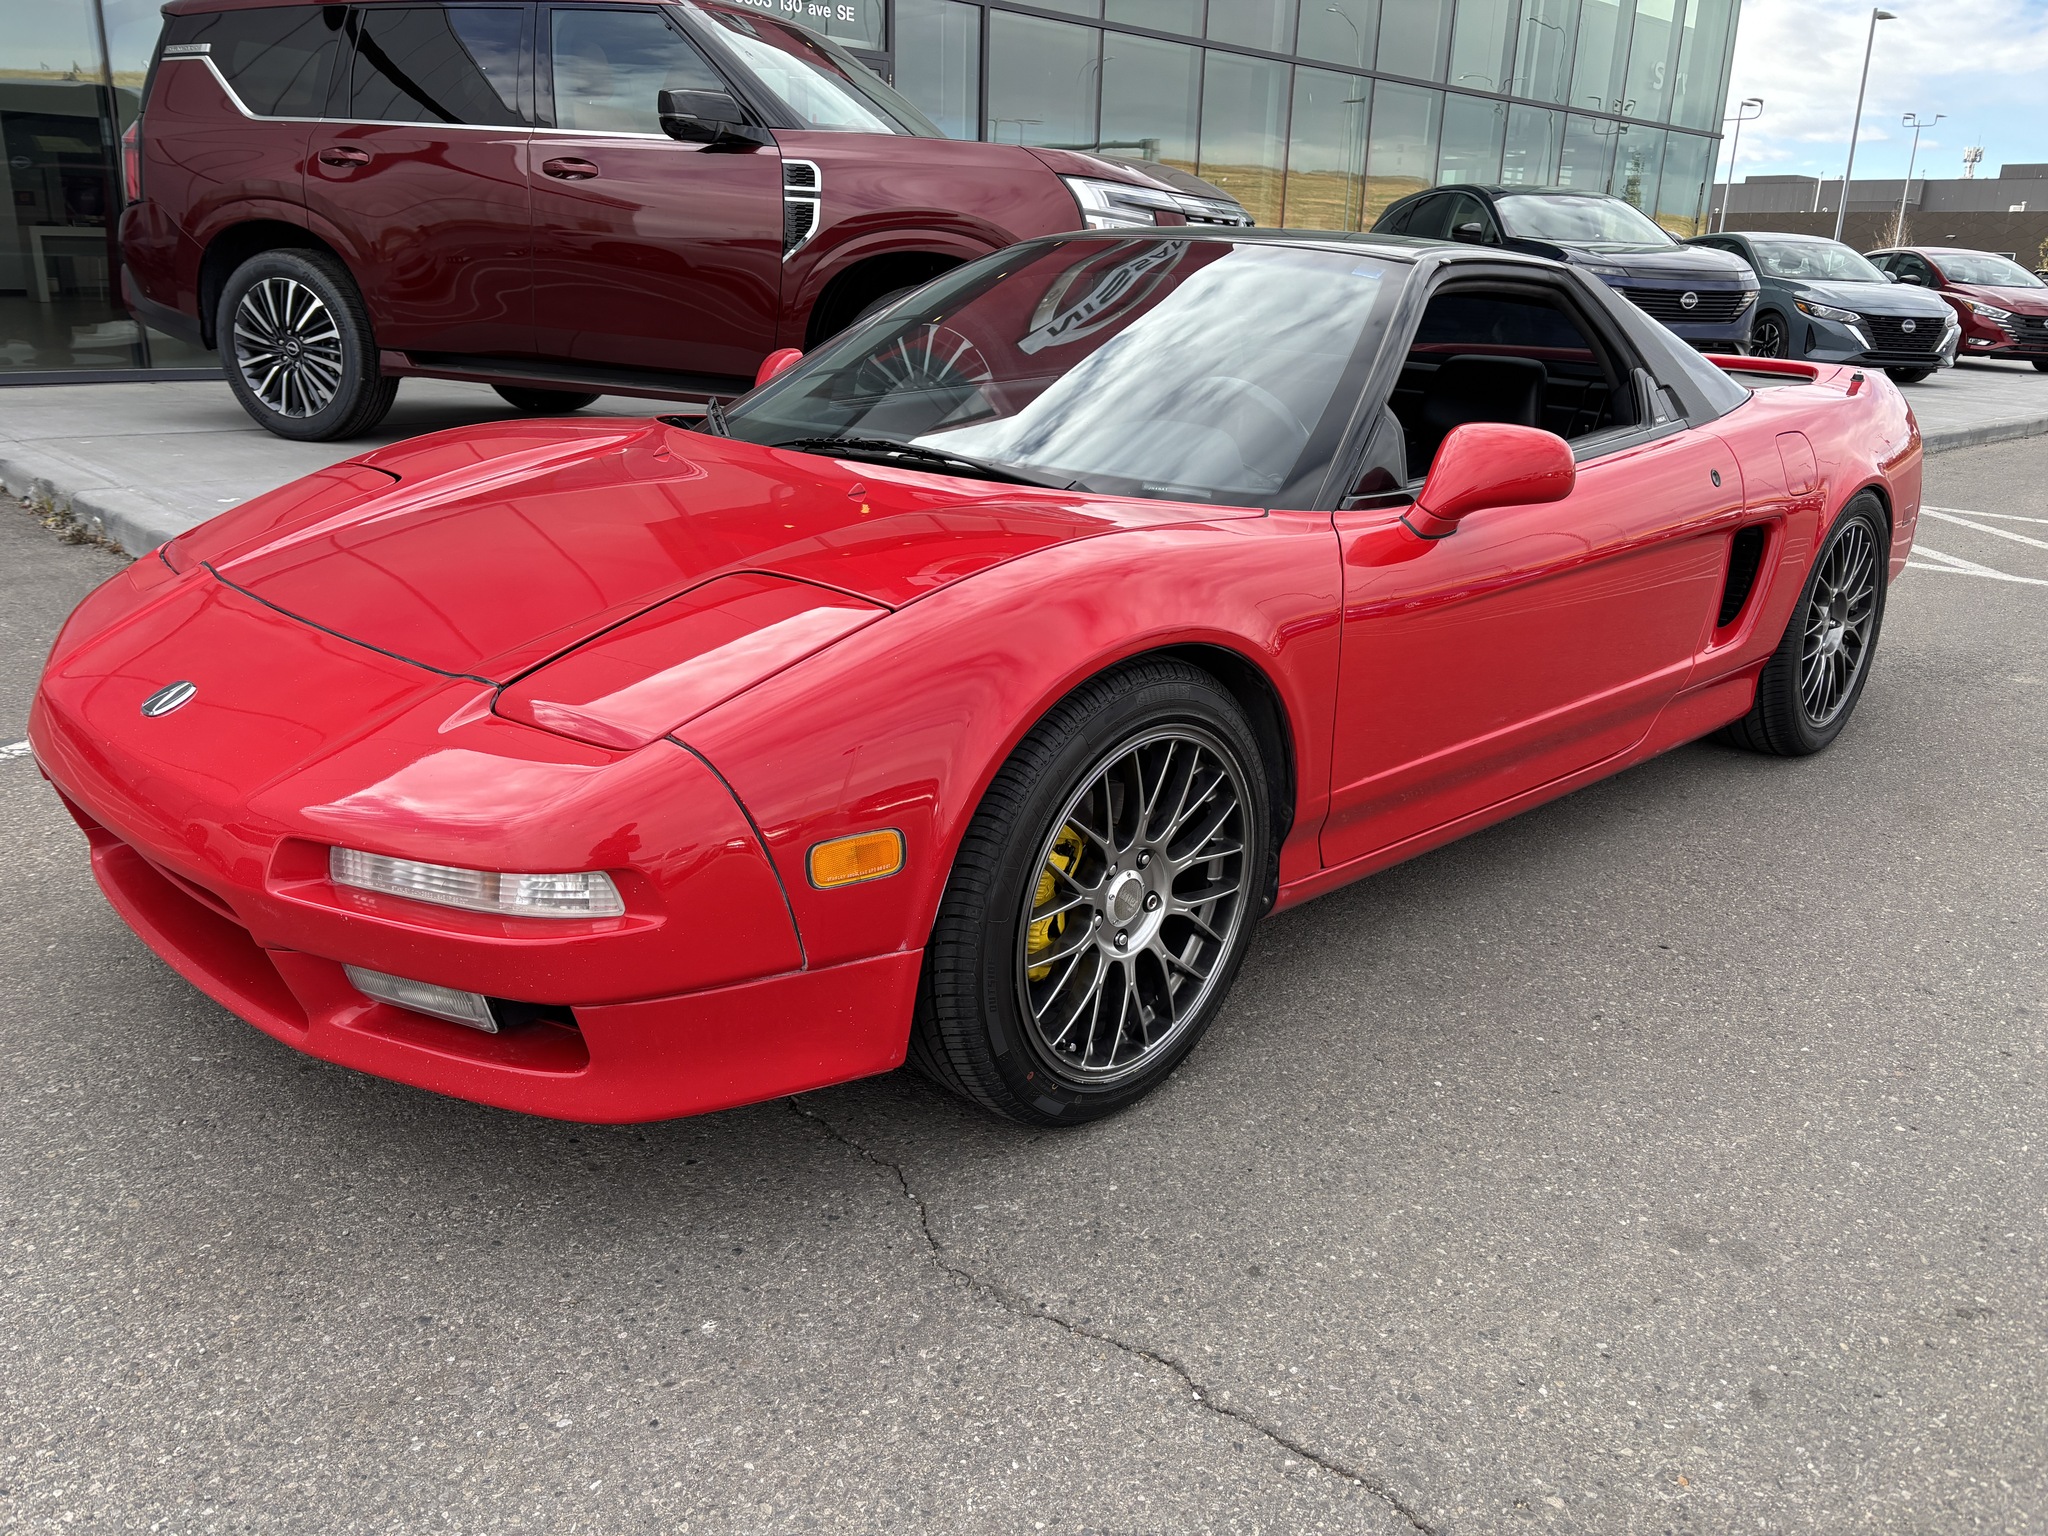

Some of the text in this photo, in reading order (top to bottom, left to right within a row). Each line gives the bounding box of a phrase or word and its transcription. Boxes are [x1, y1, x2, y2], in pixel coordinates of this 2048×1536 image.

[780, 0, 803, 13] 130
[808, 3, 831, 18] ave
[837, 4, 855, 22] SE
[987, 957, 996, 1012] OUTSIDE
